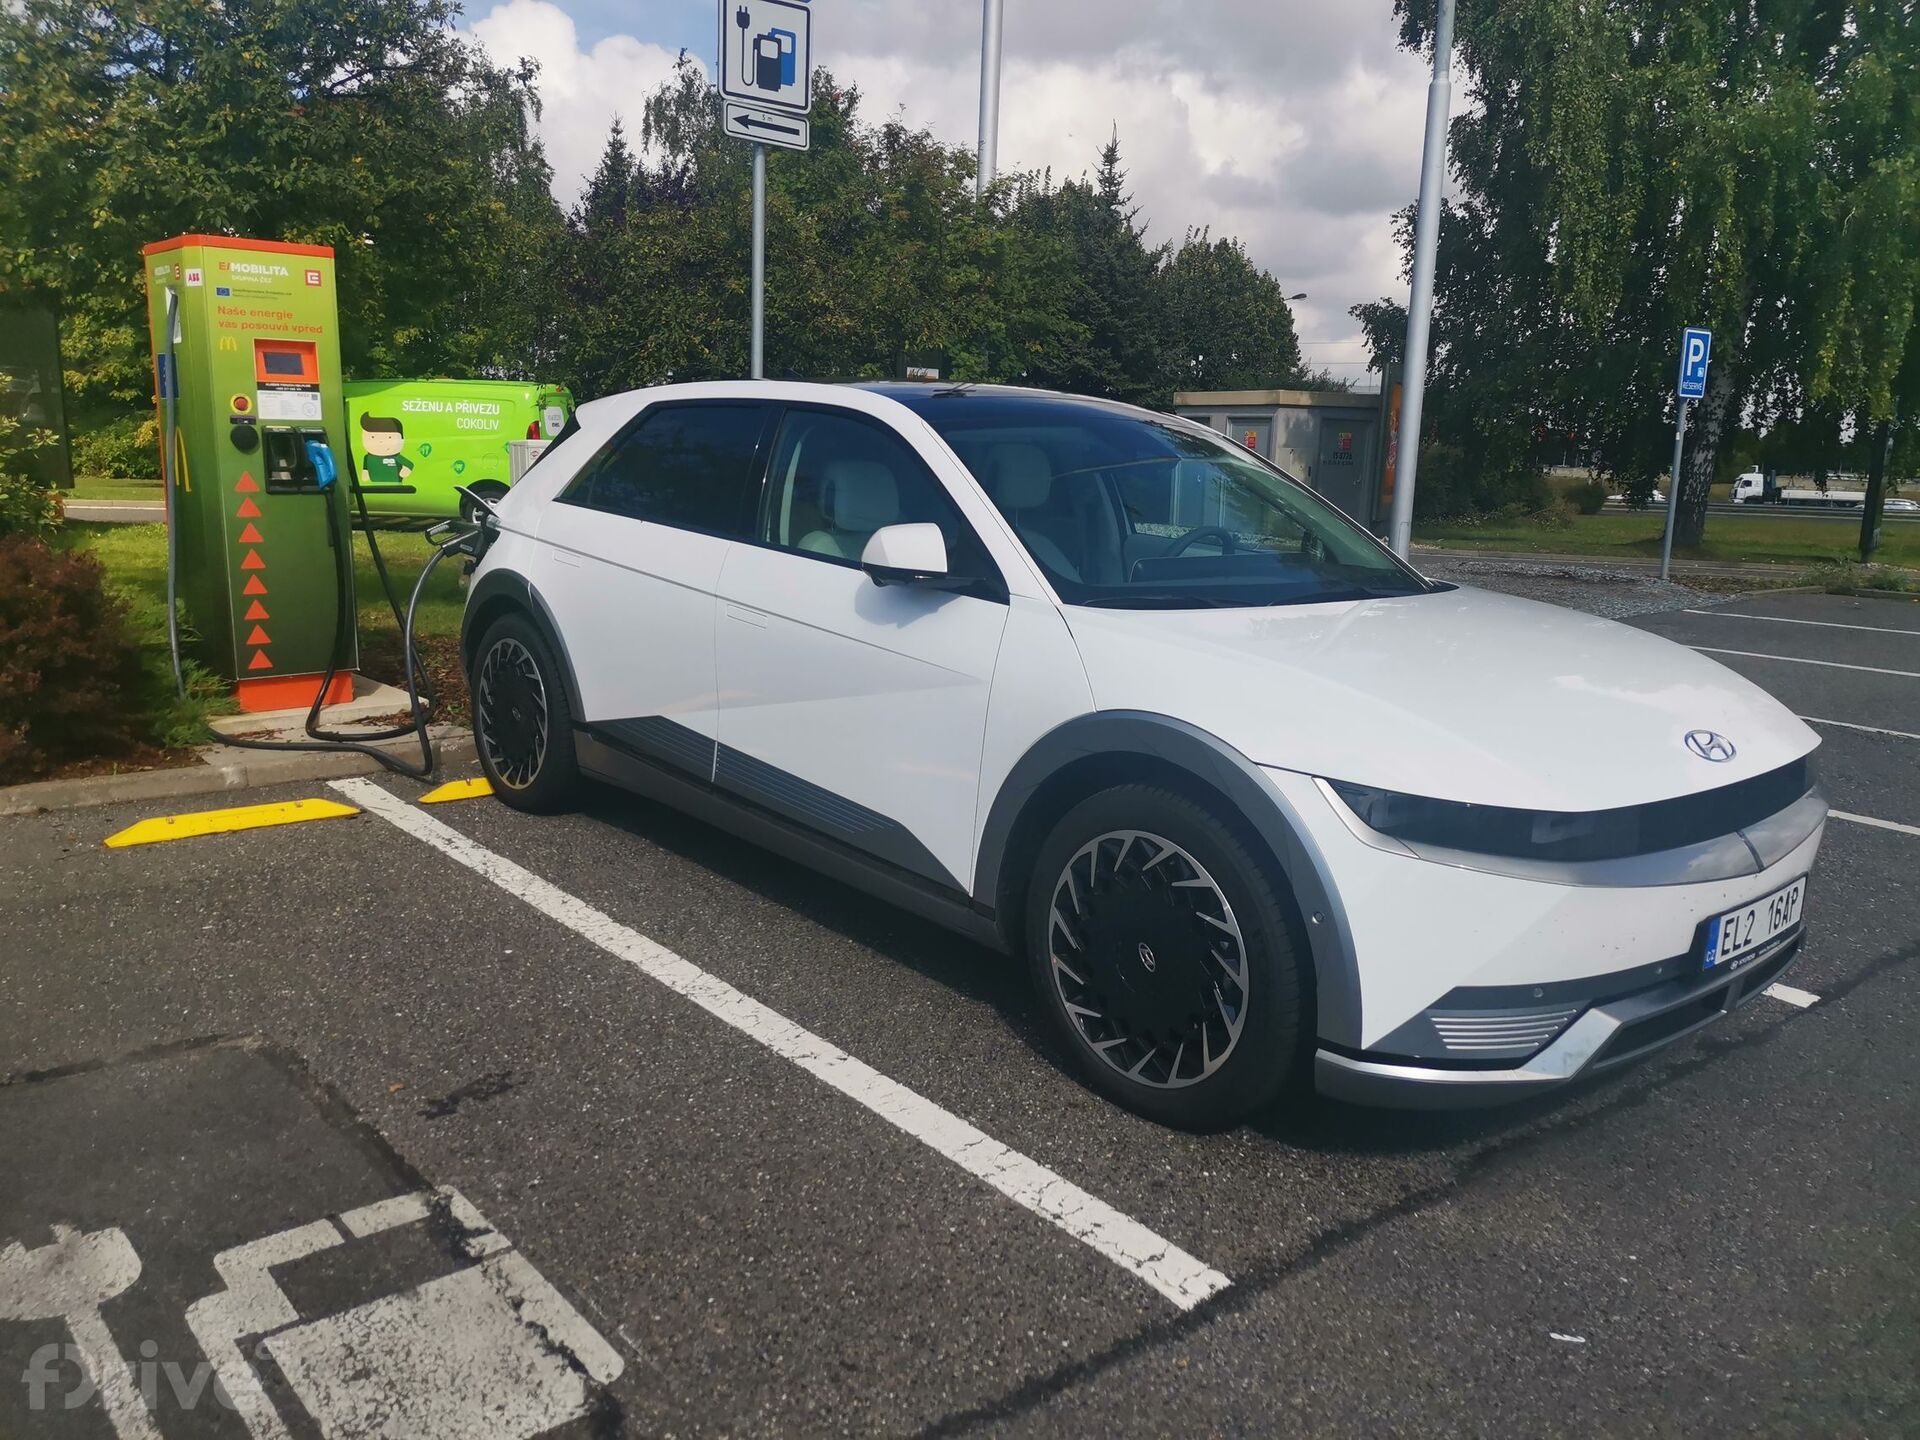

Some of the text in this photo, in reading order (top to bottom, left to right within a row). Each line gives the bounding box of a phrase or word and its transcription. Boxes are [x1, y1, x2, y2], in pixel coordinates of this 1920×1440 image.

[187, 272, 200, 282] ABB
[249, 308, 293, 321] energie
[1686, 338, 1705, 376] P
[402, 398, 500, 415] SEŽENU A PŘIVEZU
[456, 418, 499, 430] COKOLIV
[1721, 886, 1799, 956] EL2 16AP
[1706, 949, 1716, 962] CZ
